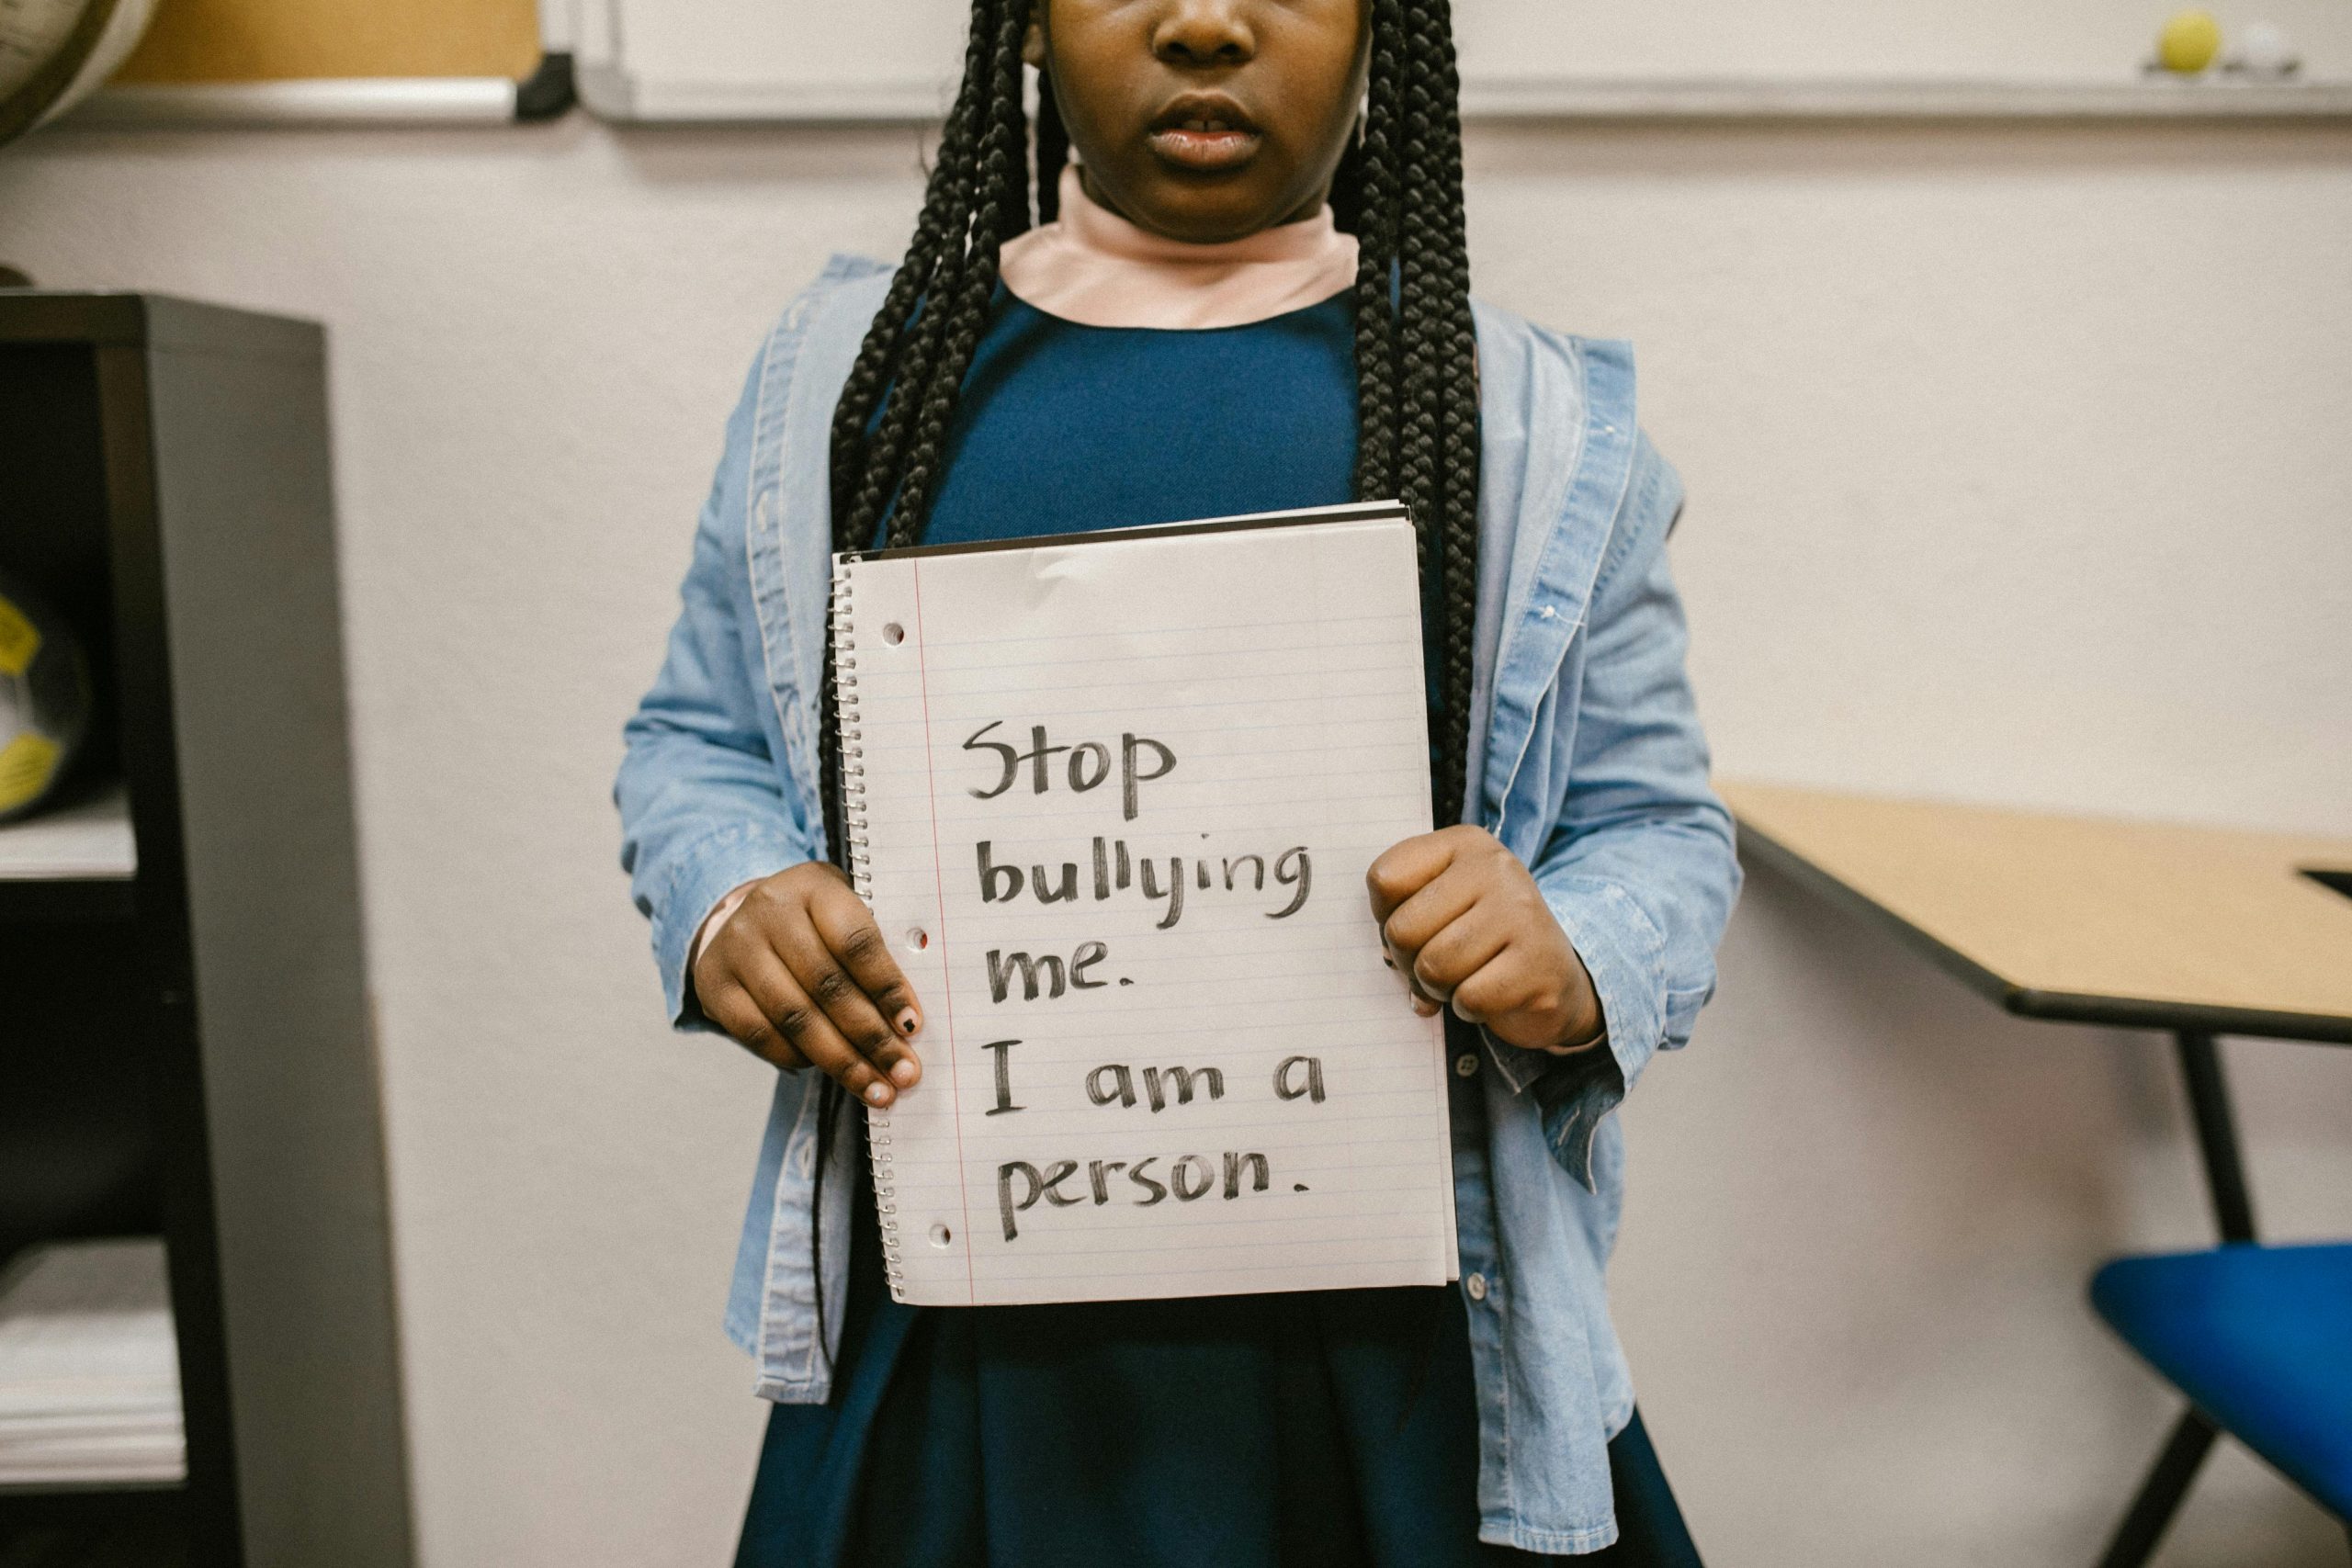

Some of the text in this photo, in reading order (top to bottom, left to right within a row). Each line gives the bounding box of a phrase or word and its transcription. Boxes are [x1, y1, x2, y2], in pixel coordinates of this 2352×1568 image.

[962, 719, 1178, 822] Stop
[976, 833, 1312, 931] bullying
[985, 940, 1136, 1005] me.
[980, 1039, 1327, 1117] I am a
[997, 1150, 1311, 1243] person.
